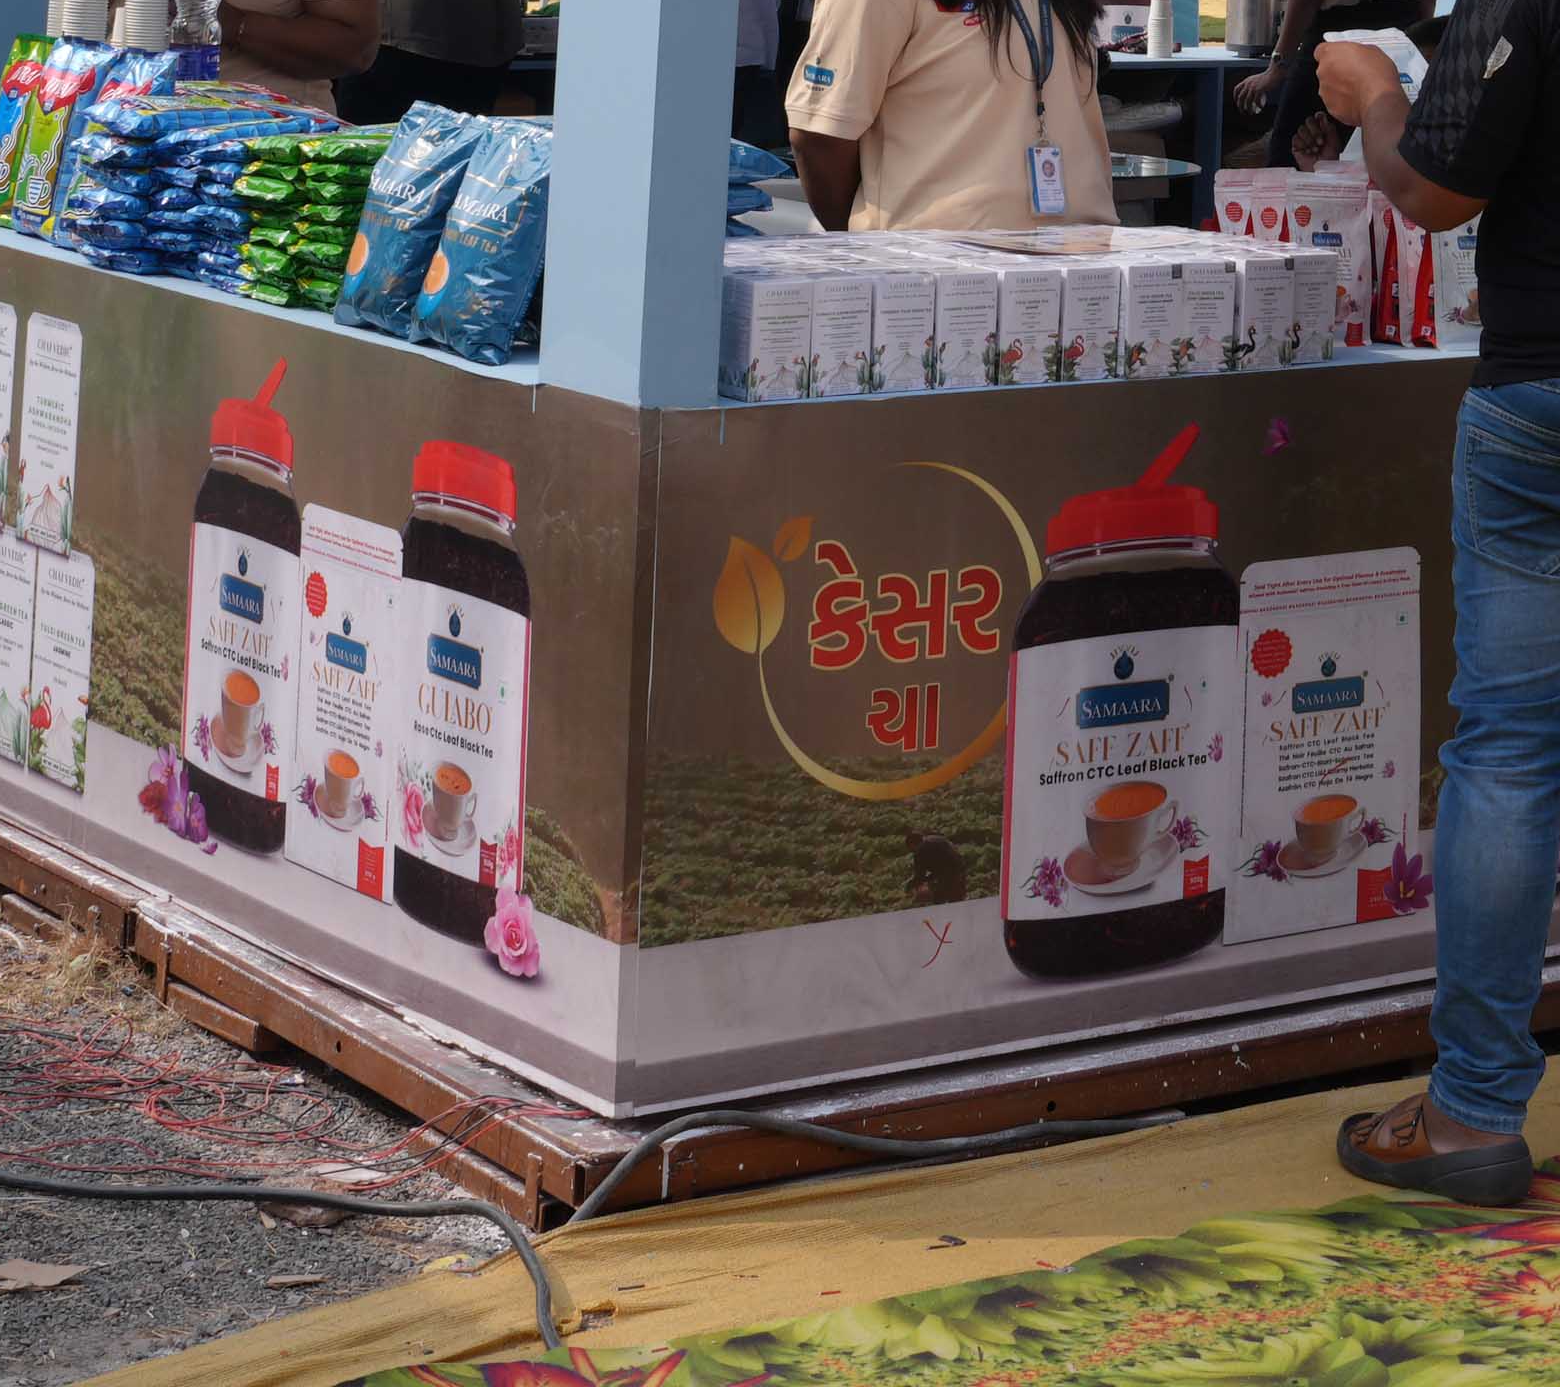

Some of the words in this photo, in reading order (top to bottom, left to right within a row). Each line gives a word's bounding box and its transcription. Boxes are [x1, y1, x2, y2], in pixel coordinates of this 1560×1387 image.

[807, 539, 1003, 673] કેસર
[201, 637, 223, 658] Saffron
[223, 647, 236, 663] CTC
[237, 652, 252, 669] Leaf
[252, 659, 270, 676] Black
[417, 682, 492, 736] GULABO
[866, 683, 940, 753] ચા
[443, 731, 460, 749] Leaf
[460, 736, 480, 755] Black
[481, 743, 494, 759] Tea
[1055, 734, 1117, 768] SAFF
[1126, 725, 1188, 758] ZAFF
[1039, 767, 1084, 786] Saffron
[1086, 764, 1115, 781] CTC
[1117, 759, 1148, 777] Leaf
[1149, 755, 1186, 772] Black
[1187, 753, 1208, 766] Tea
